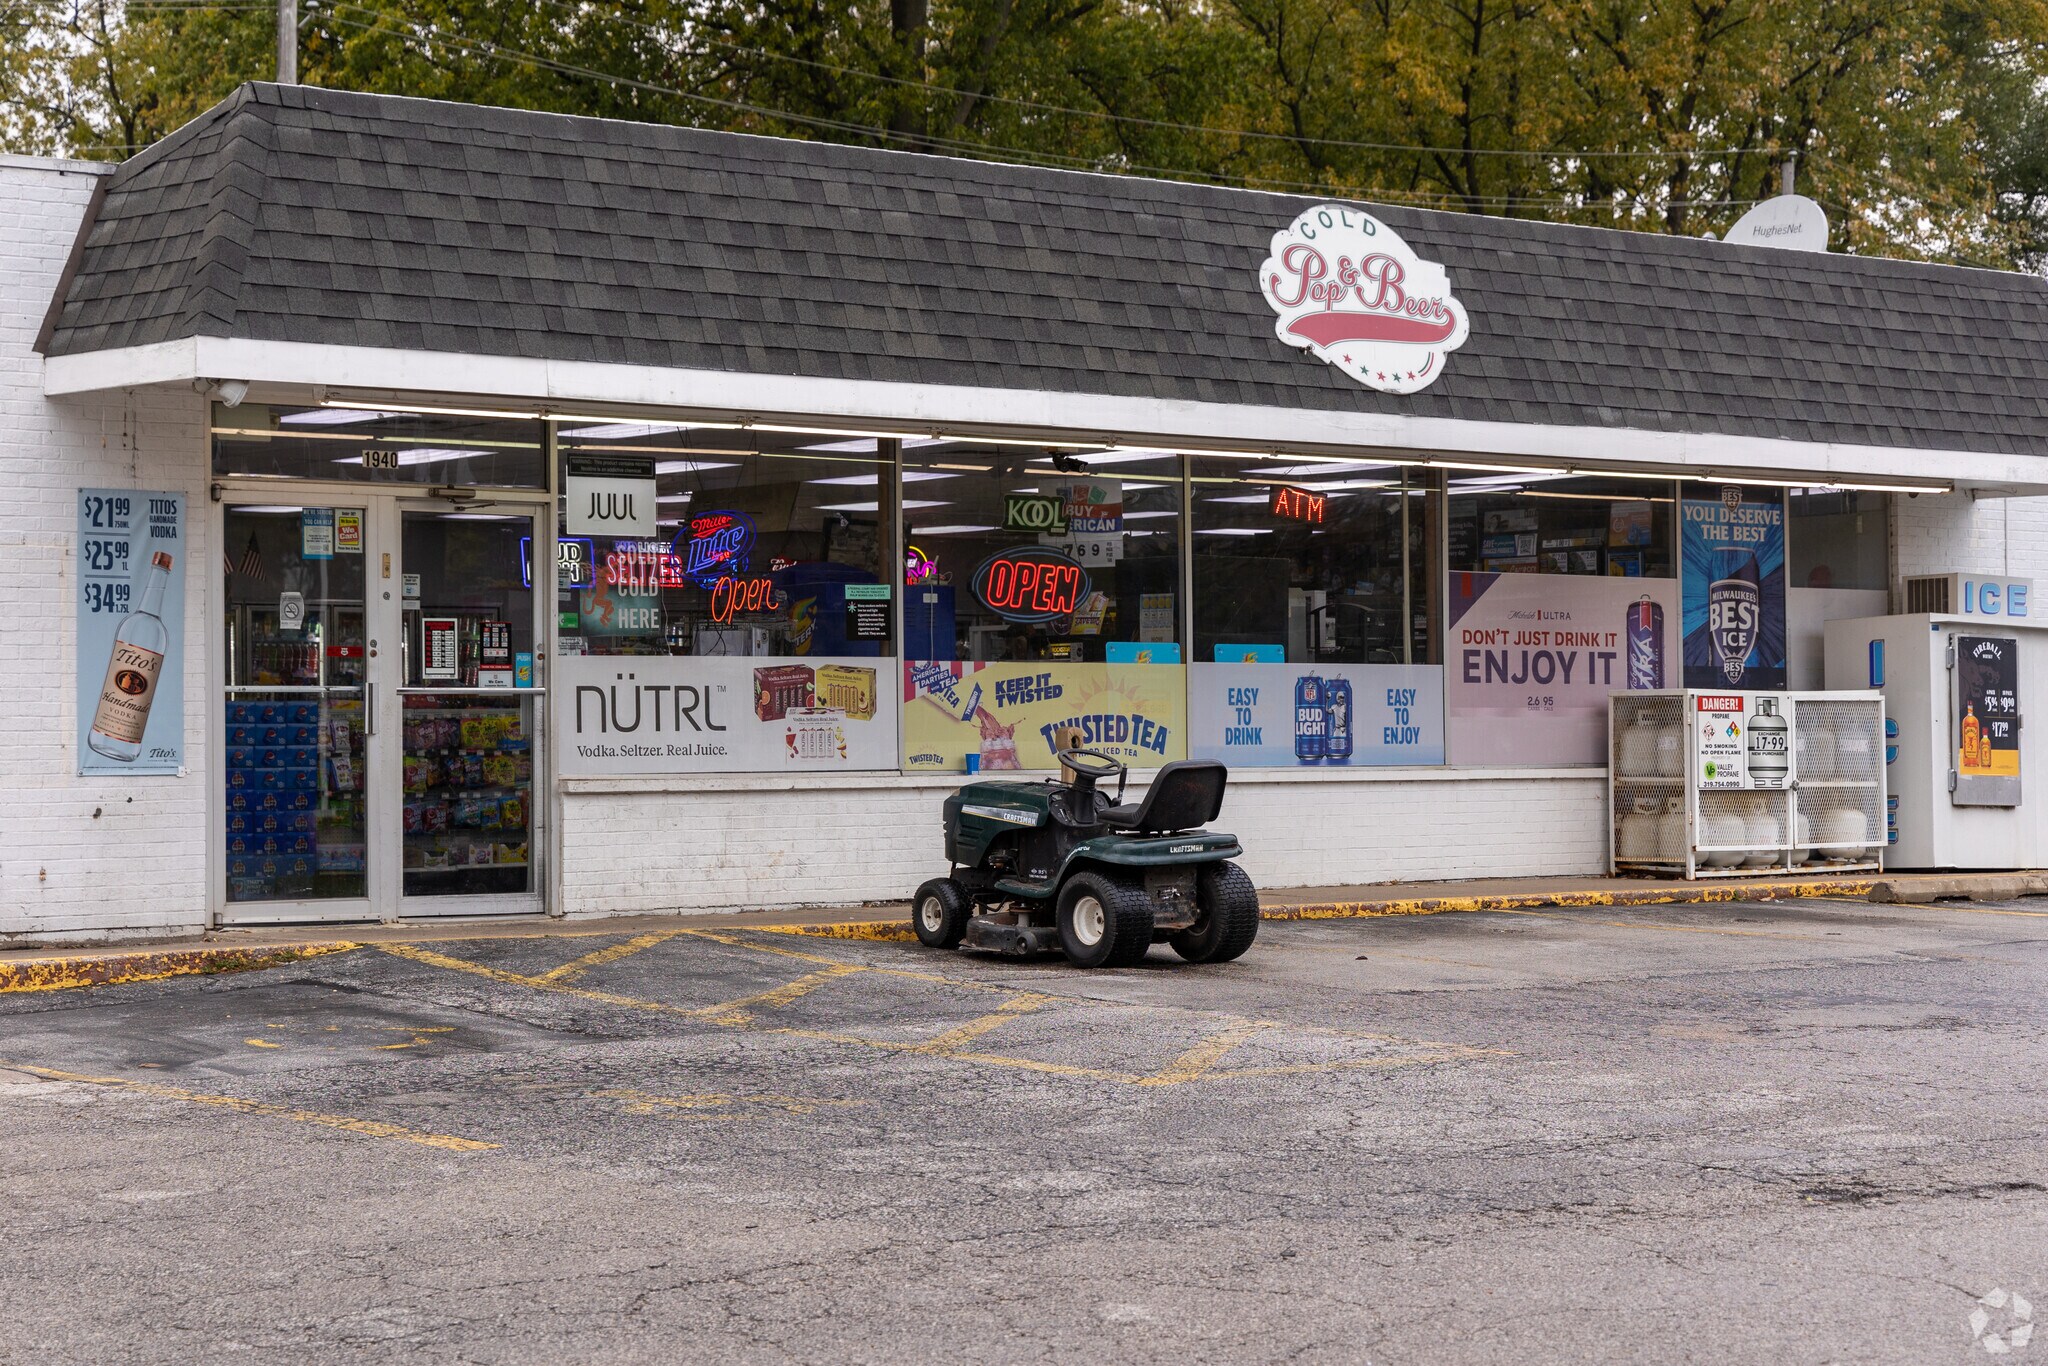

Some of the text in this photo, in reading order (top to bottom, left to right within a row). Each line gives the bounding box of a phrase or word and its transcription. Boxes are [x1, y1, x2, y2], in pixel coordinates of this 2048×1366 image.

[1300, 210, 1376, 240] COLD
[1752, 224, 1803, 238] HughesNet
[1269, 243, 1446, 320] Pop & Beer
[364, 451, 398, 468] 1940
[149, 498, 178, 515] TITOS
[588, 493, 636, 520] JUUL
[1008, 499, 1067, 528] KOOL
[1066, 505, 1094, 518] BUY
[1275, 488, 1323, 523] ATM
[149, 515, 178, 524] HANDMADE
[691, 516, 733, 531] Miller
[1684, 504, 1781, 526] YOU DESERVE
[150, 525, 178, 539] VODKA
[1701, 524, 1767, 542] THE BEST
[686, 526, 745, 574] Lite
[607, 552, 683, 587] SELTZER
[986, 559, 1080, 614] OPEN
[711, 576, 779, 625] Open
[1712, 590, 1756, 603] MILWAUKEE'S
[1965, 580, 2028, 617] ICE
[617, 608, 660, 629] HERE
[1542, 611, 1571, 621] ULTRA
[1710, 601, 1759, 633] BEST
[1462, 629, 1617, 647] DON'T JUST DRINK IT
[1722, 632, 1748, 647] ICE
[1973, 641, 2001, 660] FIREBALL
[116, 648, 158, 672] Tito's
[1462, 649, 1578, 685] ENJOY
[1588, 652, 1617, 685] IT
[1723, 662, 1745, 673] BEST
[912, 667, 940, 682] AMERICA
[921, 671, 949, 687] PARTIES
[940, 677, 958, 689] TEA
[995, 672, 1052, 694] KEEP IT
[995, 684, 1063, 708] TWISTED
[1228, 688, 1259, 706] EASY
[1305, 689, 1316, 699] NFL
[1387, 688, 1416, 706] EASY
[1527, 696, 1554, 707] 2.6 95
[1702, 697, 1739, 711] DANGER!
[109, 707, 137, 720] VODKA
[1235, 707, 1251, 726] TO
[1298, 708, 1323, 722] BUD
[1394, 707, 1409, 726] TO
[1131, 714, 1168, 756] TEA
[1225, 727, 1262, 745] DRINK
[1296, 722, 1326, 736] LIGHT
[1383, 727, 1420, 745] ENJOY
[149, 748, 177, 758] Tito's
[577, 744, 728, 758] Vodka. Seltzer. Real Juice.
[909, 754, 944, 765] TWISTED TEA
[1103, 747, 1120, 755] ICED
[1124, 748, 1138, 757] TEA
[1716, 770, 1740, 778] PROPANE
[1004, 812, 1037, 826] CRAFTSMAN
